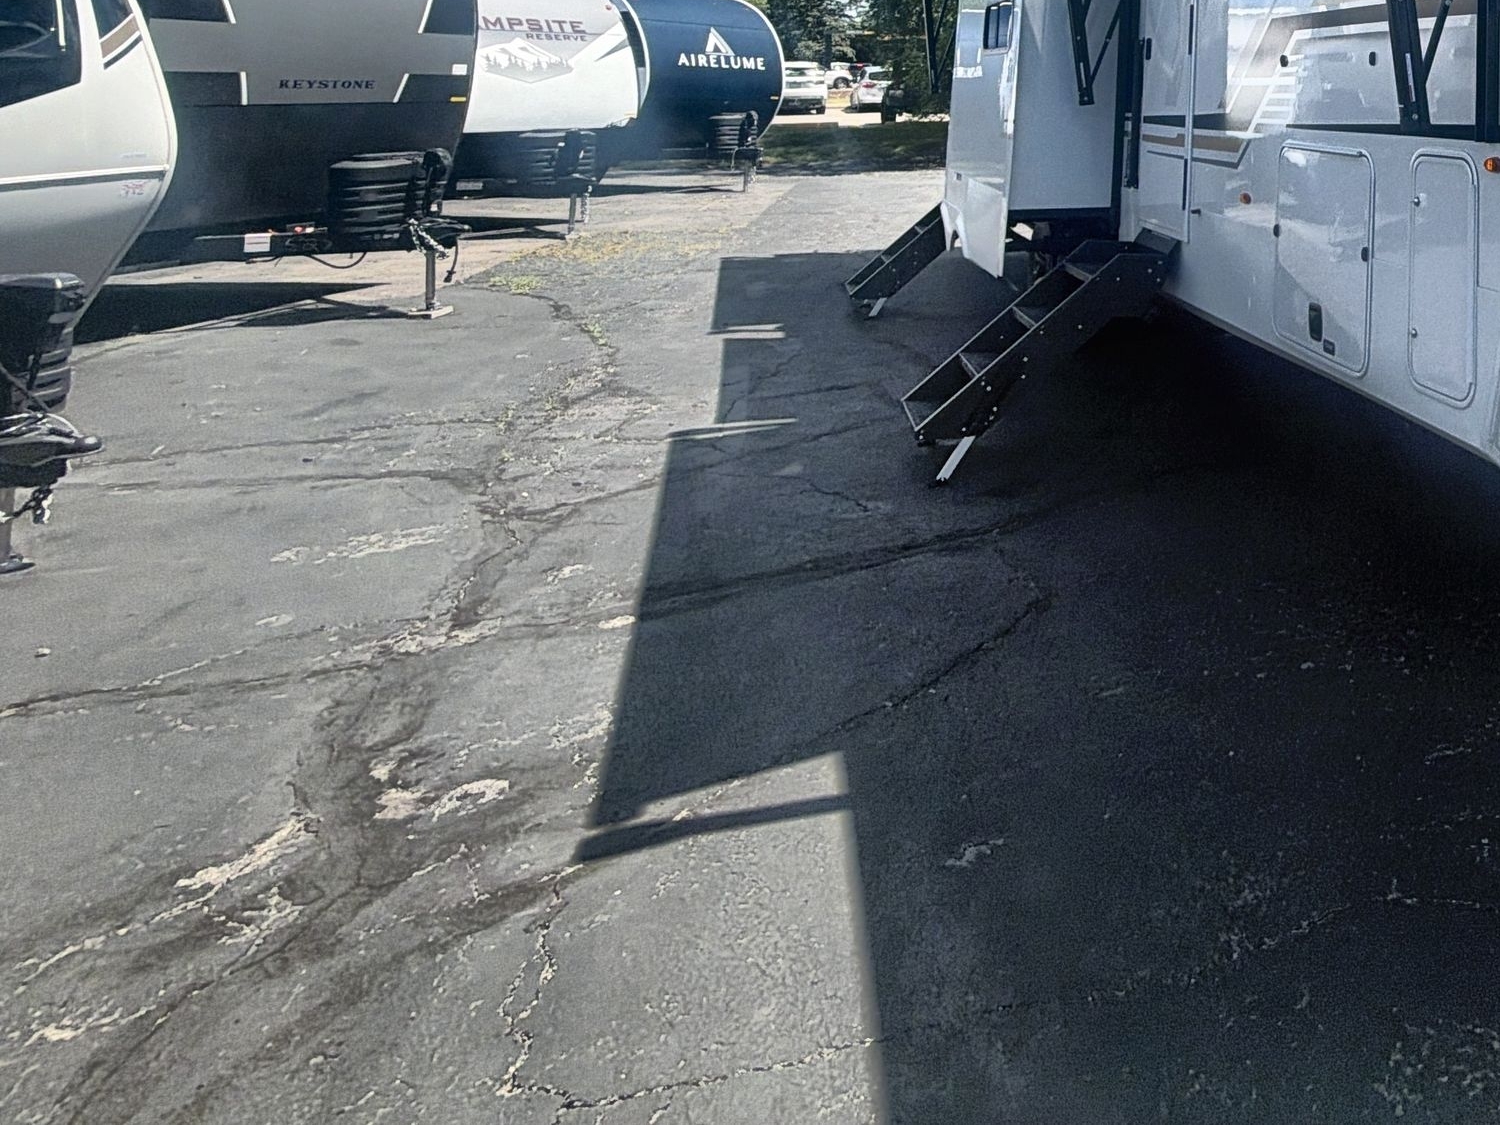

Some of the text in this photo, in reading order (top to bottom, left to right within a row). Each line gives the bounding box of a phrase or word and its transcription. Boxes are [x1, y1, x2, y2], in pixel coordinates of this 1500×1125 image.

[479, 16, 587, 34] MPSITE
[525, 33, 588, 43] RESERVE
[677, 53, 766, 71] AIRELUME
[279, 79, 376, 90] KEYSTONE
